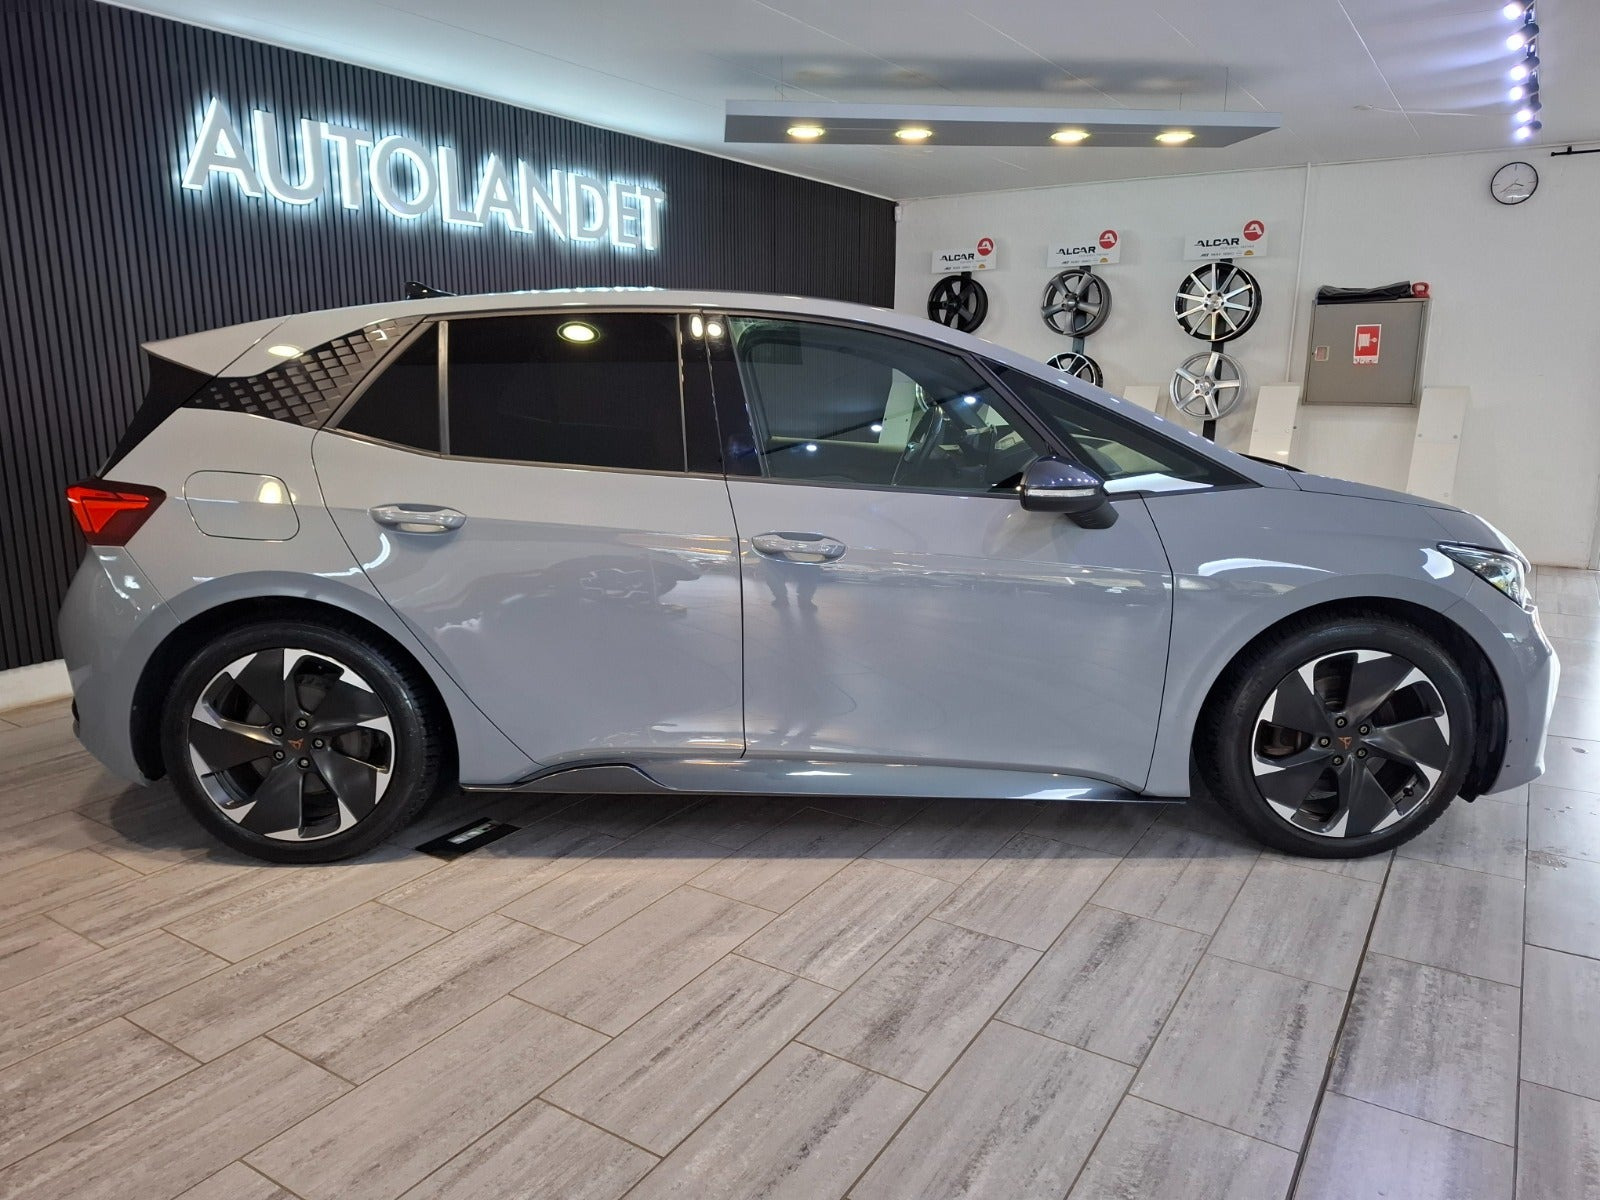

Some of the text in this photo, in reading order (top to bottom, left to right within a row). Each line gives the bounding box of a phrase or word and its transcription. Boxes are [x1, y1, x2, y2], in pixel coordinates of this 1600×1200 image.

[182, 97, 665, 250] AUTOLANDET
[1194, 237, 1240, 248] ALCAR
[1056, 246, 1096, 256] ALCAR
[940, 253, 975, 262] ALCAR
